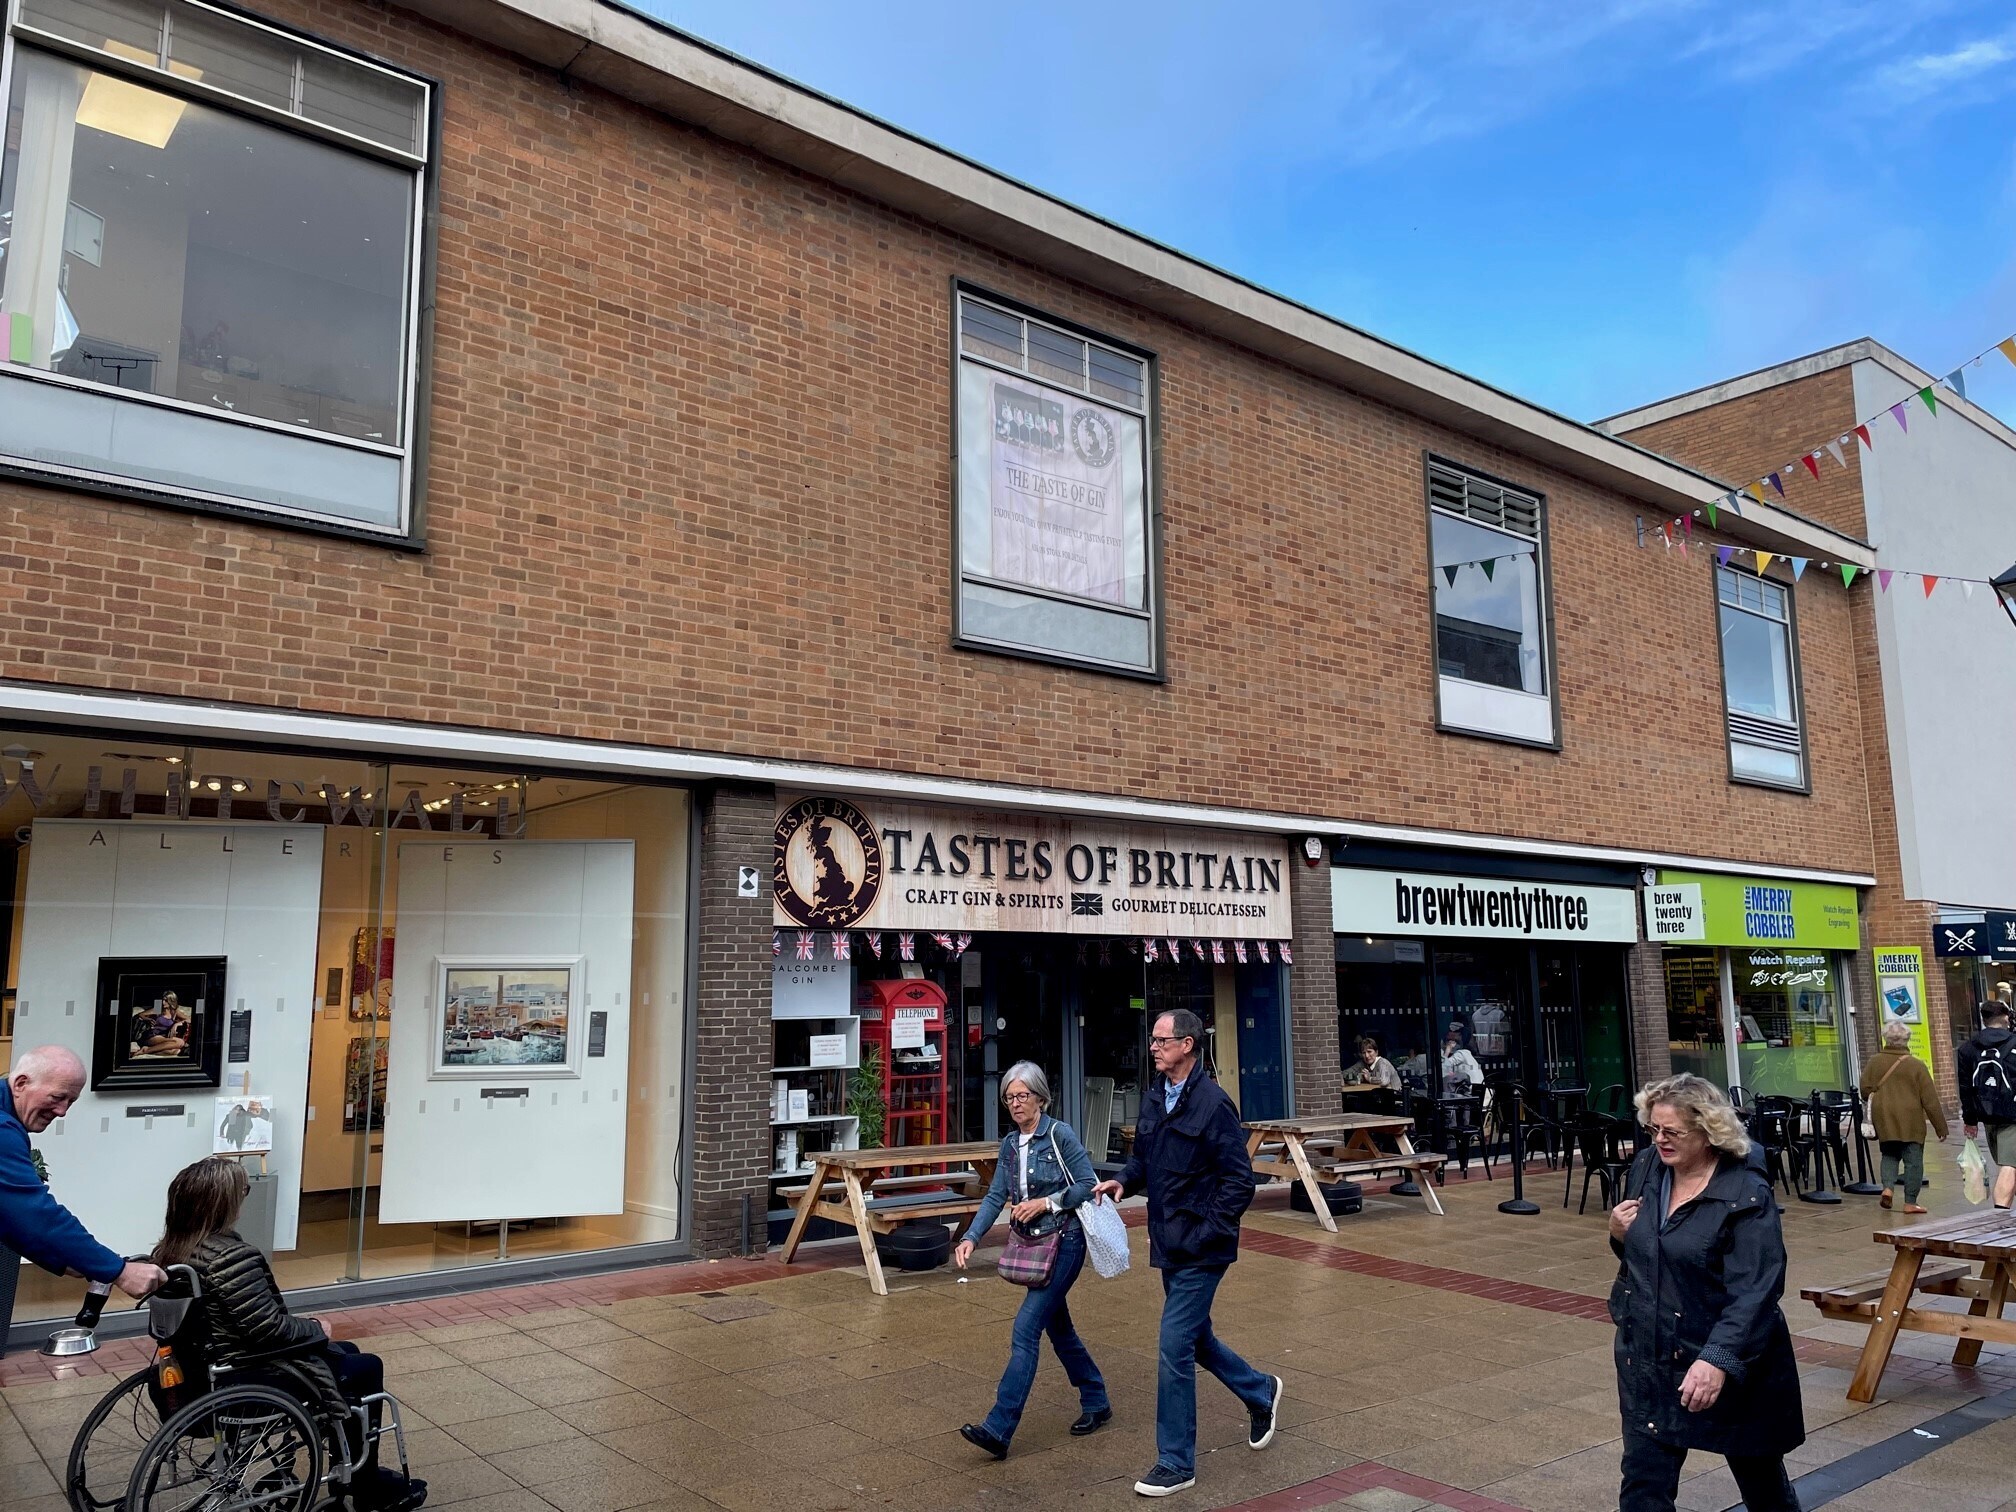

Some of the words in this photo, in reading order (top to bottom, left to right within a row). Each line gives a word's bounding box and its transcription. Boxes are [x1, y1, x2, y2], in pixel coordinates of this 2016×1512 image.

[1006, 467, 1029, 489] THE
[1032, 474, 1068, 498] TASTE
[1071, 484, 1085, 503] OF
[1088, 489, 1106, 510] GIN
[774, 813, 798, 901] TASTES
[801, 800, 825, 818] OF
[832, 801, 879, 886] BRITAIN
[883, 828, 1053, 880] TASTES
[1066, 844, 1117, 883] OF
[1130, 848, 1281, 893] BRITAIN
[905, 888, 958, 905] CRAFT
[963, 891, 990, 906] GIN
[995, 893, 1005, 907] &
[1009, 893, 1063, 909] SPIRITS
[1654, 892, 1682, 904] brew
[1751, 887, 1792, 913] MERRY
[1112, 898, 1176, 914] GOURMET
[1180, 901, 1266, 917] DELICATESSEN
[1396, 878, 1588, 933] brewtwentythree
[1823, 904, 1837, 913] Watch
[1838, 905, 1854, 915] Repairs
[1655, 906, 1692, 919] twenty
[1656, 921, 1685, 933] three
[1746, 912, 1795, 939] COBBLER
[1829, 918, 1850, 929] Engraving
[1749, 955, 1783, 965] Watch
[1785, 955, 1826, 966] Repairs
[1883, 955, 1918, 963] MERRY
[1878, 964, 1920, 973] COBBLER
[898, 1008, 936, 1018] TELEPHONE
